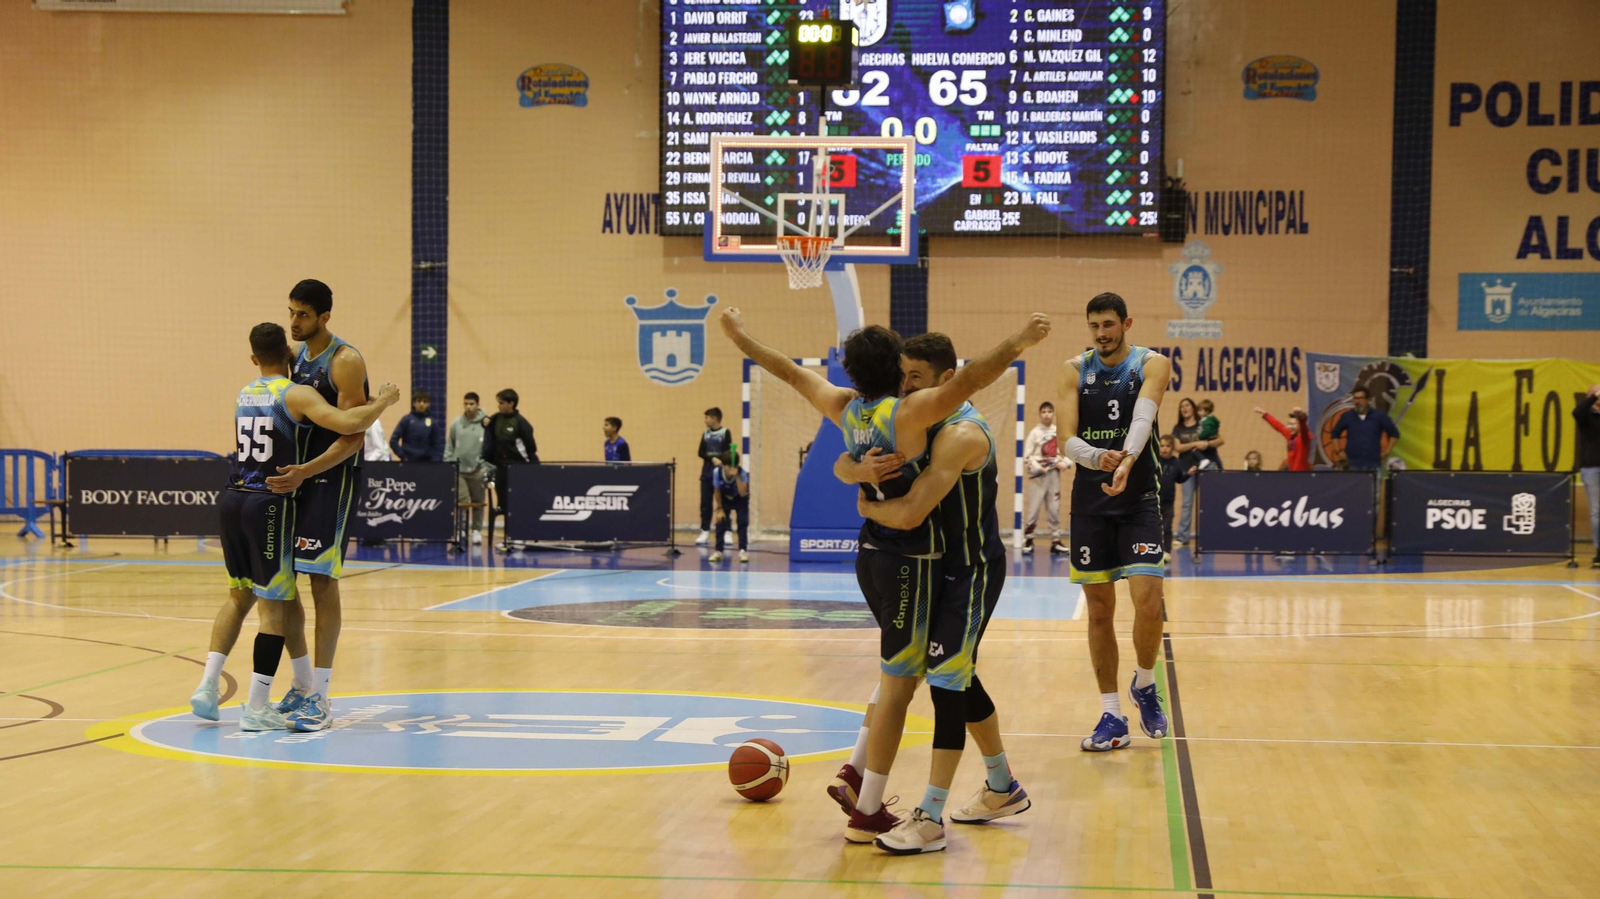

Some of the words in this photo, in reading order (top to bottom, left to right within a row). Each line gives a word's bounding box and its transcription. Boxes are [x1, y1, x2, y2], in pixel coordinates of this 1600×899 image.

[670, 12, 677, 25] 1
[683, 11, 714, 25] DAVID
[716, 11, 748, 25] ORRIT
[1009, 9, 1018, 23] 2
[1023, 9, 1035, 22] C.
[1037, 9, 1075, 22] GAINES
[1142, 8, 1152, 21] 9
[669, 32, 678, 45] 2
[683, 33, 711, 44] JAVIER
[712, 32, 762, 44] BALASTEGUI
[1009, 29, 1018, 43] 4
[1023, 29, 1035, 43] C.
[1036, 29, 1083, 42] MINLEND
[1142, 28, 1152, 41] 0
[669, 52, 678, 65] 3
[683, 52, 707, 65] JERE
[709, 52, 746, 65] VUCICA
[859, 52, 905, 66] GECIRAS
[911, 53, 950, 65] HUELVA
[952, 52, 1006, 65] COMERCIO
[1009, 50, 1018, 63] 6
[1023, 50, 1036, 63] M.
[1038, 50, 1084, 64] VAZQUEZ
[1085, 49, 1103, 62] GIL
[1142, 49, 1157, 62] 12
[669, 71, 678, 85] 7
[683, 71, 715, 84] PABLO
[718, 71, 758, 84] FERCHO
[1009, 70, 1018, 83] 7
[1023, 71, 1033, 82] A.
[1033, 71, 1067, 82] ARTILES
[1067, 71, 1104, 82] AGUILAR
[1141, 69, 1157, 82] 10
[929, 69, 988, 106] 65
[667, 92, 680, 105] 10
[683, 92, 717, 105] WAYNE
[719, 91, 760, 105] ARNOLD
[798, 91, 805, 106] 1
[1008, 90, 1017, 104] 9
[1023, 90, 1035, 103] G.
[1036, 90, 1079, 103] BOAHEN
[1141, 90, 1156, 103] 10
[667, 111, 680, 125] 14
[683, 111, 695, 124] A.
[698, 111, 753, 125] RODRIGUEZ
[798, 111, 807, 125] 8
[977, 111, 995, 121] TM
[1005, 110, 1020, 124] 10
[1033, 110, 1072, 122] BALDERAS
[1072, 109, 1103, 122] MARTÍN
[1141, 110, 1151, 123] 0
[666, 131, 680, 145] 21
[683, 132, 709, 145] SAMI
[1005, 131, 1019, 144] 12
[1022, 131, 1034, 144] K.
[1140, 131, 1150, 144] 6
[965, 143, 999, 151] FALTAS
[666, 151, 681, 165] 22
[721, 151, 754, 165] ARCIA
[798, 151, 810, 165] 17
[886, 153, 932, 166] PEDO
[1005, 151, 1020, 164] 13
[1022, 151, 1033, 164] S.
[1034, 151, 1069, 164] NDOYE
[1140, 151, 1150, 164] 0
[666, 171, 681, 185] 29
[727, 172, 761, 183] REVILLA
[797, 172, 804, 185] 1
[972, 160, 992, 183] 5
[1005, 171, 1019, 184] 15
[1021, 171, 1033, 184] A.
[1034, 170, 1072, 184] FADIKA
[1140, 171, 1149, 184] 3
[665, 191, 680, 205] 35
[682, 191, 706, 205] ISSA
[969, 194, 982, 204] EN
[1003, 191, 1019, 205] 23
[1021, 191, 1034, 205] M.
[1036, 191, 1060, 204] FALL
[1139, 191, 1154, 205] 12
[665, 212, 681, 225] 55
[683, 212, 692, 225] V.
[797, 212, 806, 225] 0
[964, 209, 1001, 221] GABRIEL
[1205, 189, 1309, 235] MUNICIPAL
[954, 220, 1001, 231] CARRASCO
[1530, 306, 1582, 318] Algeciras
[1195, 346, 1301, 392] ALGECIRAS
[1107, 399, 1120, 421] 3
[1433, 369, 1483, 471] LA
[237, 416, 274, 462] 55
[368, 478, 383, 488] Bar
[386, 477, 416, 495] Pepe
[81, 489, 133, 506] BODY
[136, 489, 220, 506] FACTORY
[365, 487, 442, 519] Troya
[552, 495, 630, 511] ALGESUR
[1427, 499, 1472, 507] ALGECIRAS
[1226, 495, 1345, 529] Socibus
[1426, 507, 1487, 530] PSOE
[261, 505, 277, 560] damex.io
[1080, 546, 1091, 565] 3
[893, 565, 910, 629] damex.io
